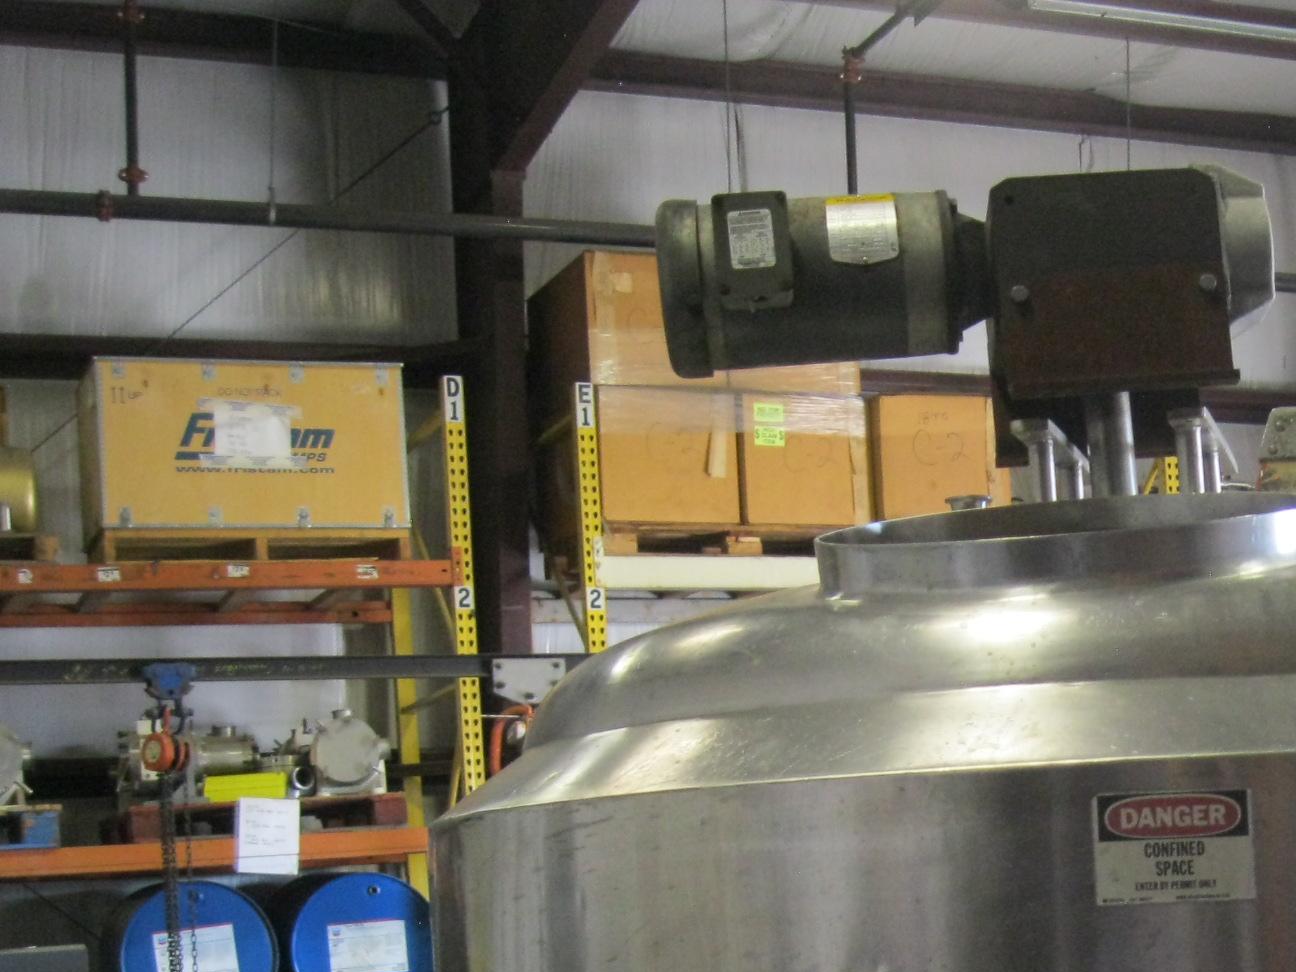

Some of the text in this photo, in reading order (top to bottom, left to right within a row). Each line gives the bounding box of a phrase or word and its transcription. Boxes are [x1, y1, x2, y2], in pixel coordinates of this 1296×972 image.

[446, 377, 460, 397] D
[578, 384, 591, 403] E
[450, 401, 459, 420] 1
[582, 407, 590, 426] 1
[458, 588, 471, 608] 2
[590, 589, 601, 609] 2
[1119, 804, 1227, 829] DANGER
[1144, 840, 1205, 858] CONFINED
[1155, 859, 1195, 877] SPACE
[1135, 879, 1217, 891] ENTER BY PERMIT ONLY
